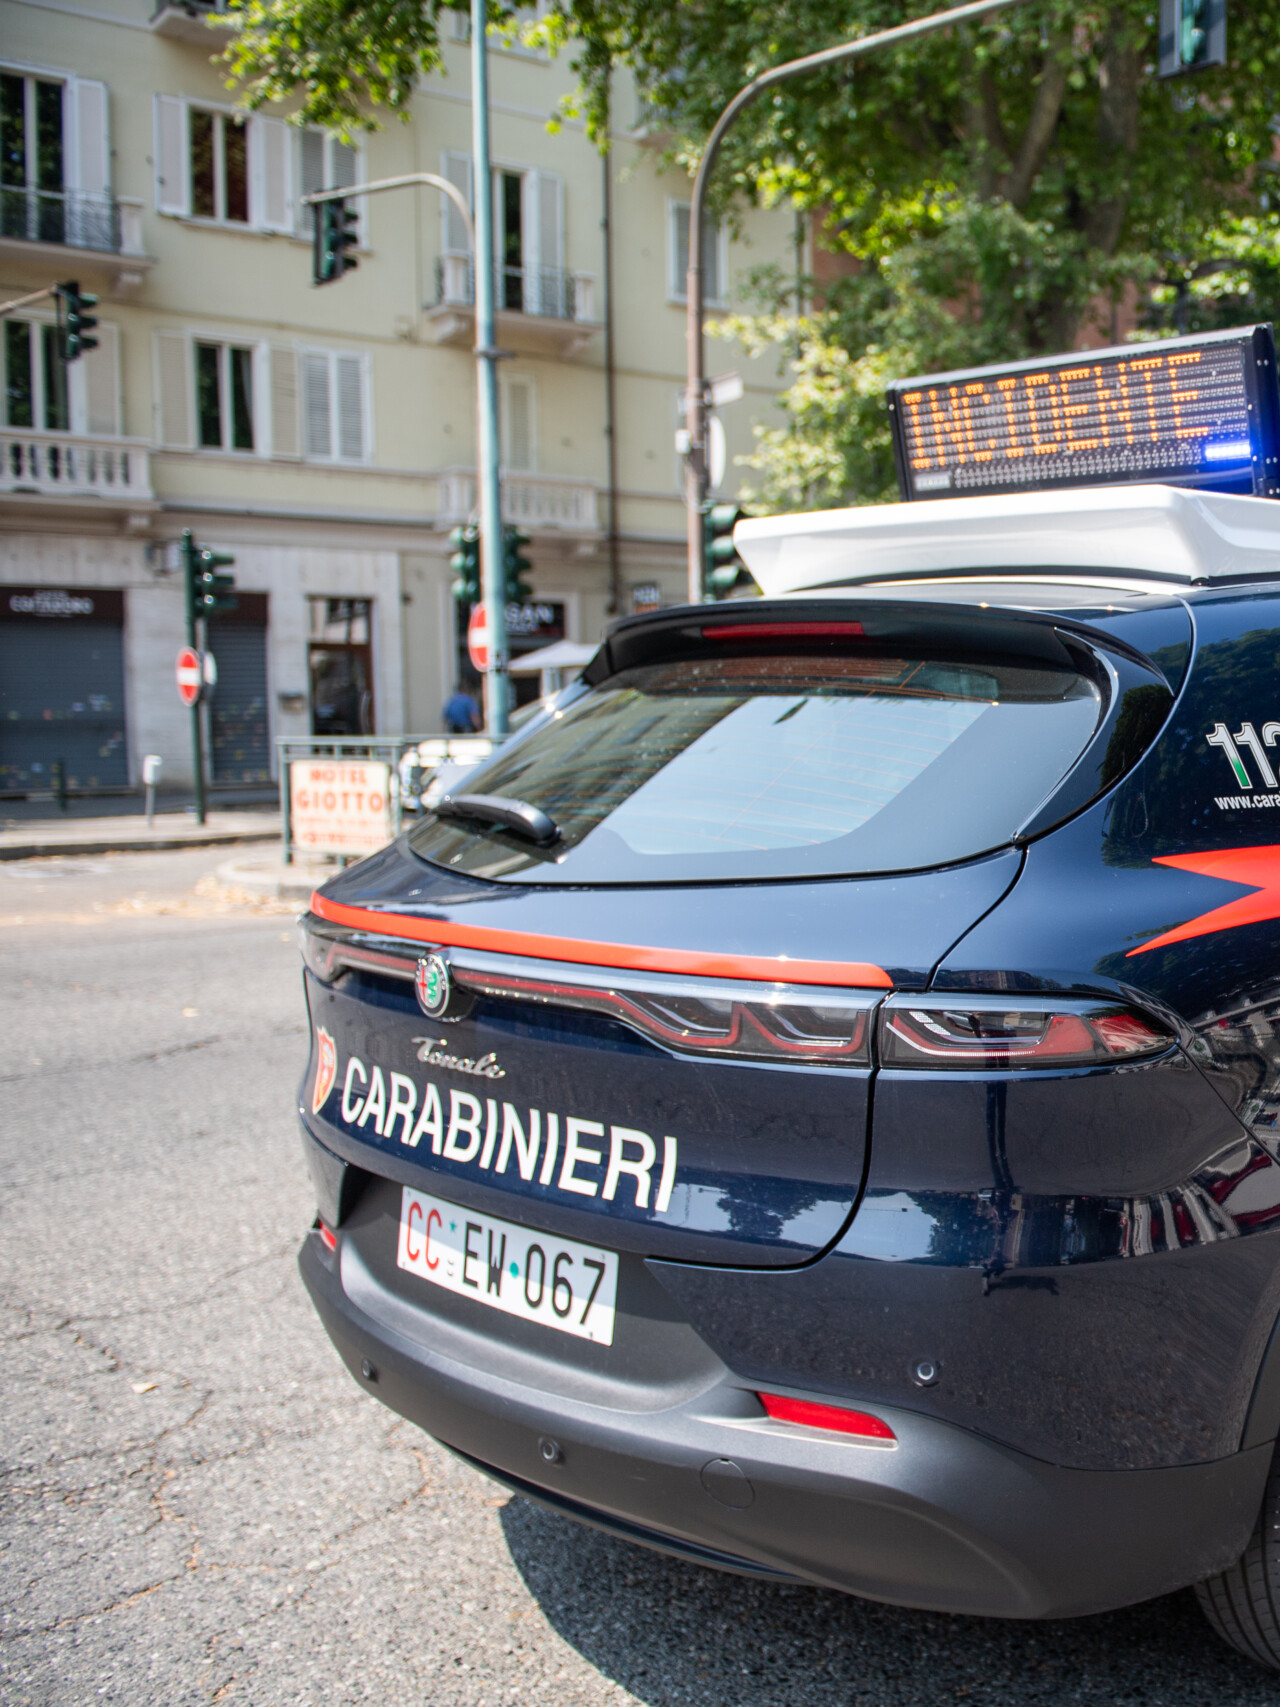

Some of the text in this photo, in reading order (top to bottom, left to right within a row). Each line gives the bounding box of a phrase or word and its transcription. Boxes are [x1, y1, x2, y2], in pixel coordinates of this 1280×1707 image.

[904, 352, 1209, 469] INCIDENTE
[310, 769, 367, 785] HOTEL
[296, 789, 385, 813] GIOTTO
[411, 1036, 506, 1079] Tonale
[342, 1057, 677, 1212] CARABINIERI
